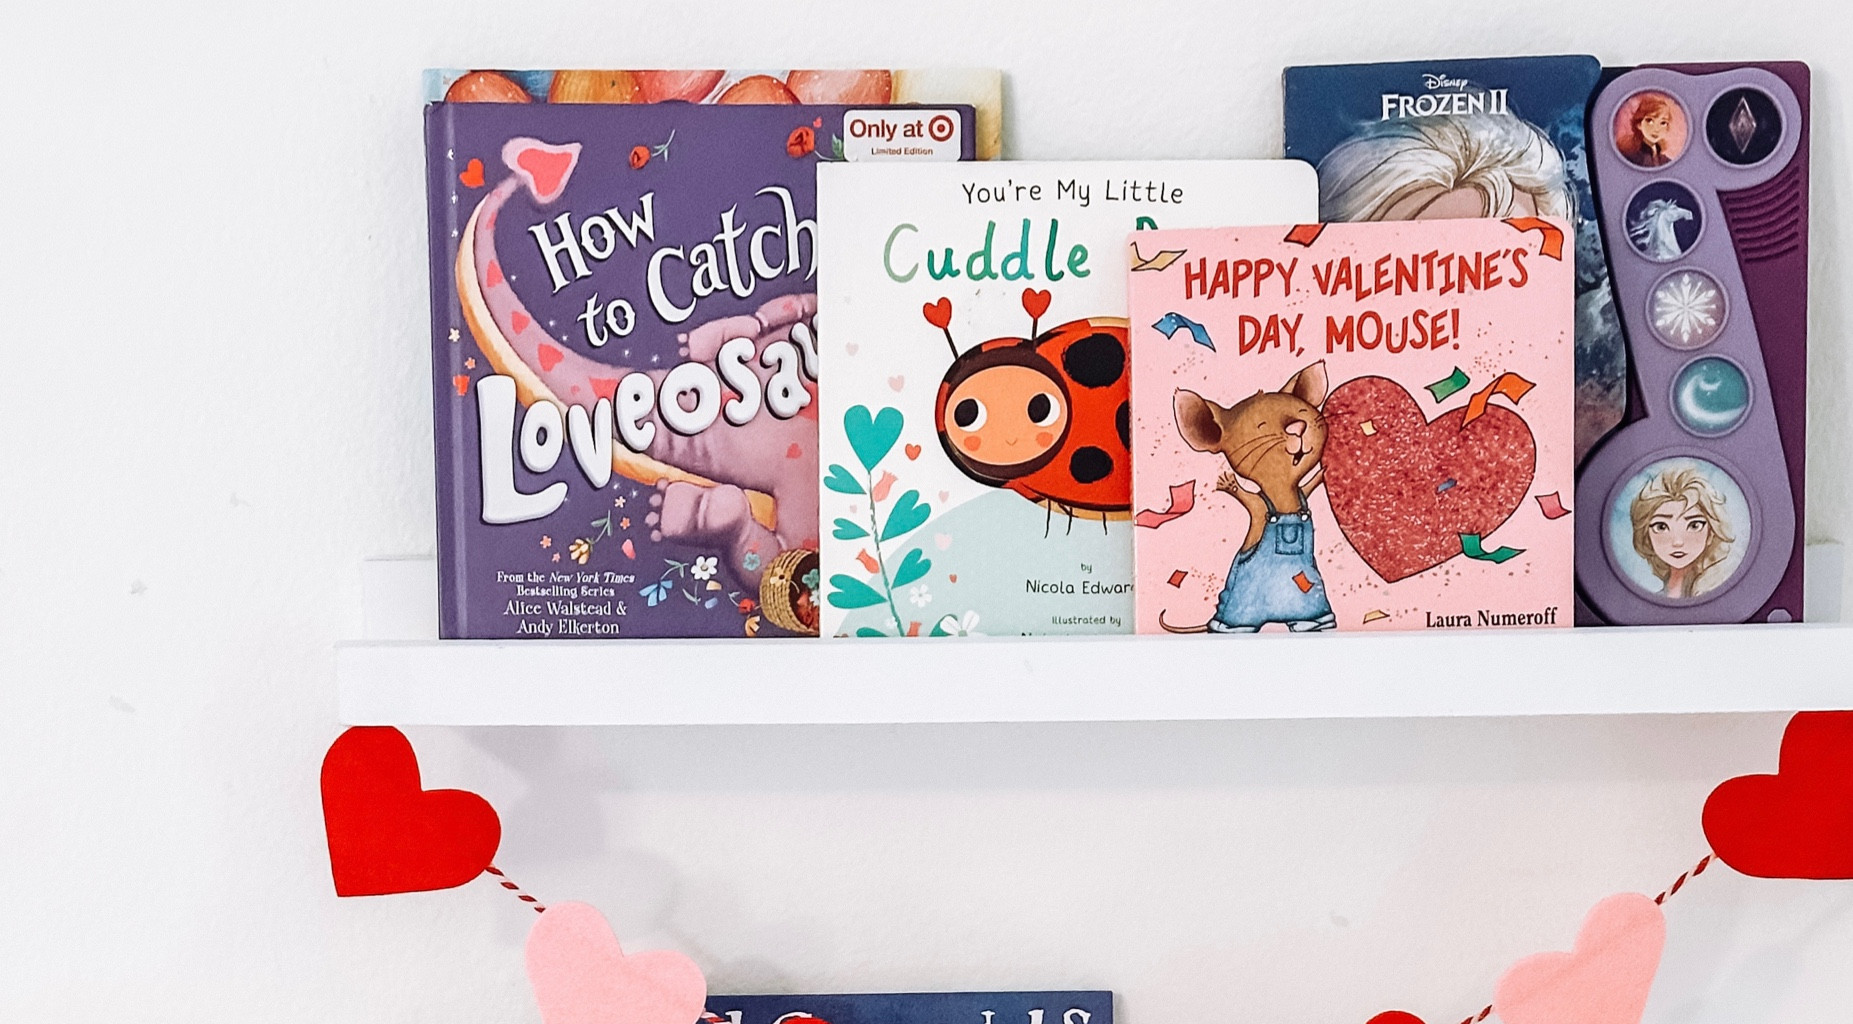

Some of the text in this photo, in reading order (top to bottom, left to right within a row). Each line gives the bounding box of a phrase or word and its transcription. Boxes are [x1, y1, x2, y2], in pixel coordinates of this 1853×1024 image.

[1422, 74, 1468, 91] Disney
[1381, 88, 1509, 121] FROZEN II
[849, 119, 923, 142] Only at
[871, 147, 933, 155] Limited Edition
[962, 178, 1183, 208] You're My Little
[528, 192, 655, 293] How
[883, 217, 1091, 283] Cuddle
[576, 186, 817, 347] to Catch
[1184, 247, 1529, 302] HAPPY VALENTINE'S
[1238, 308, 1460, 357] DAY, MOUSE!
[496, 571, 635, 584] From the New York Times
[1080, 562, 1093, 574] by
[516, 585, 615, 599] Bestselling Series
[1026, 579, 1075, 594] Nicola
[503, 600, 627, 616] Alice Walstead &
[1426, 607, 1558, 628] Laura Numeroff
[516, 619, 620, 637] Andy Elkerton
[1052, 616, 1121, 626] Illustrated by
